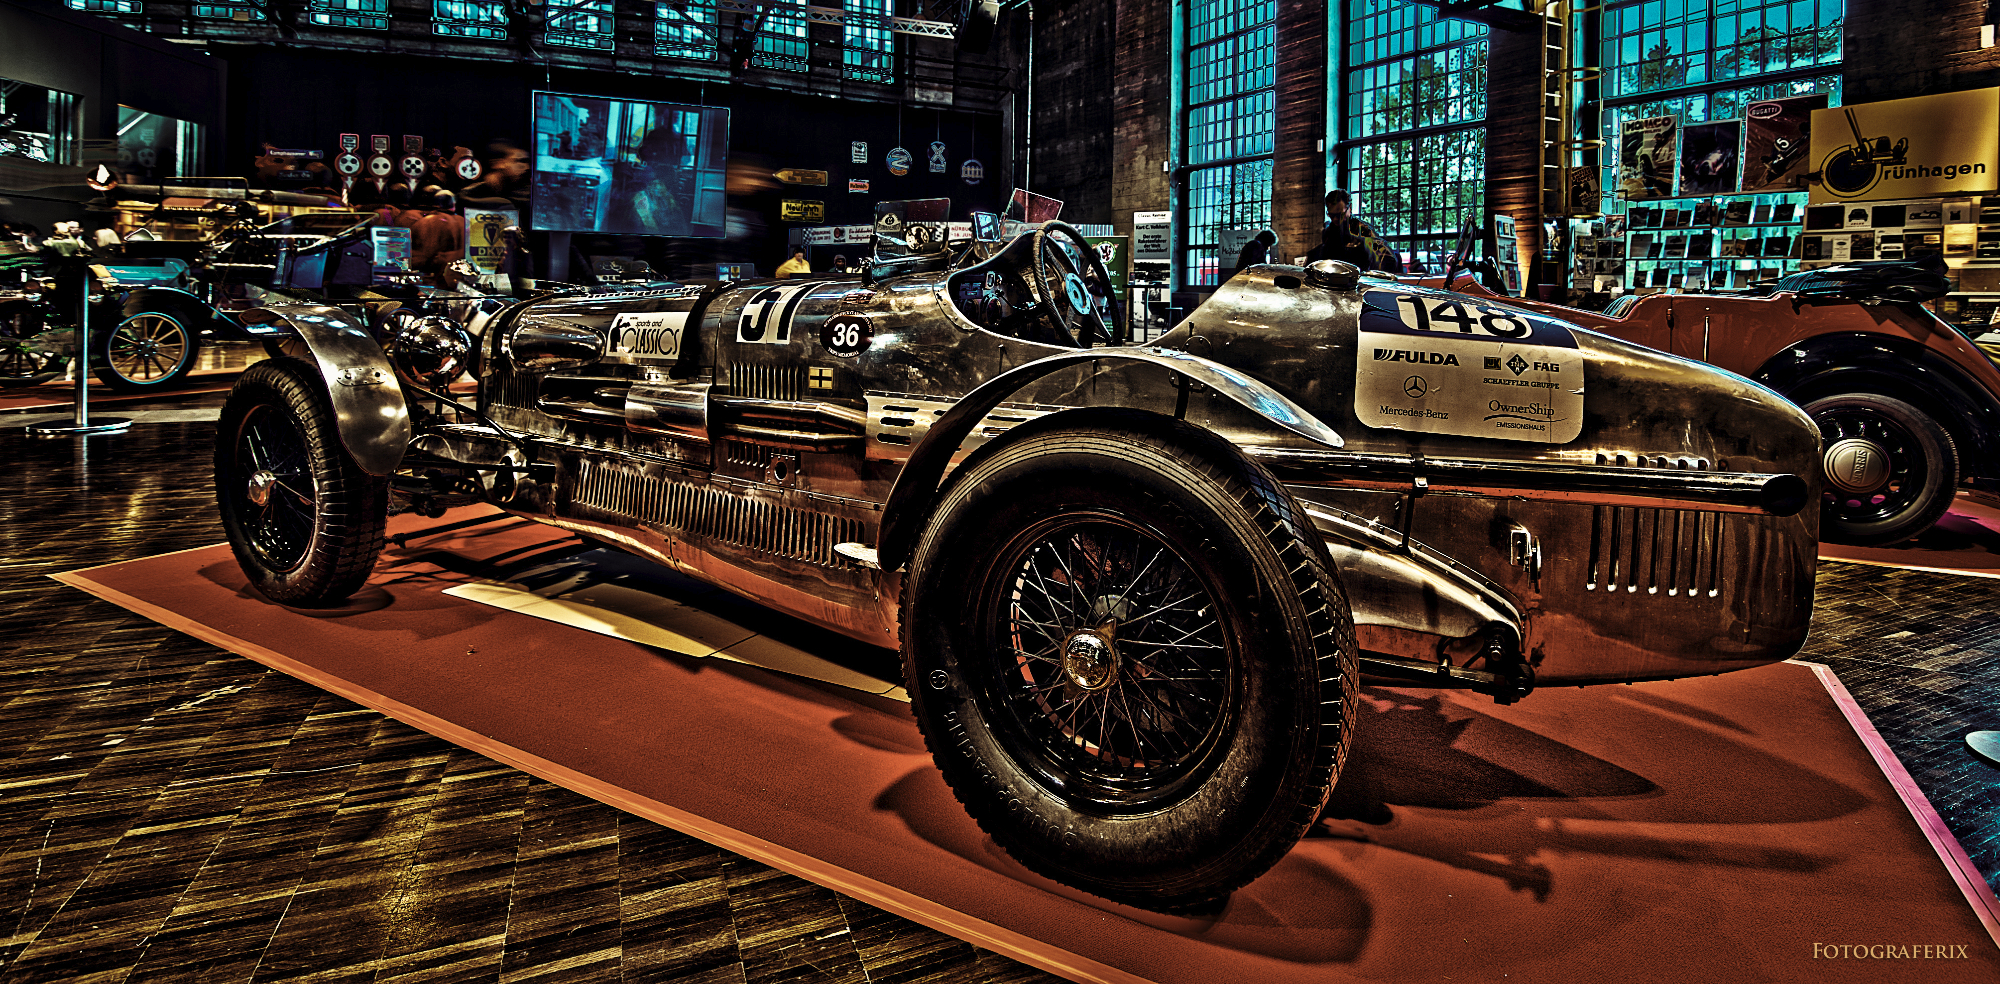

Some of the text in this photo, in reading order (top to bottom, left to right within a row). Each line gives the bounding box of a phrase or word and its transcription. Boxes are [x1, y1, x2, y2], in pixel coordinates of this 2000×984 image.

[1750, 106, 1778, 116] BUGATTI
[1626, 117, 1672, 132] MONACO
[1776, 137, 1790, 148] 5
[635, 318, 664, 329] sports and
[1398, 296, 1527, 338] 148
[621, 328, 679, 355] CLASSICS
[832, 323, 860, 347] 36
[1397, 350, 1460, 367] FULDA
[1533, 361, 1560, 373] FAG
[1483, 377, 1560, 390] SCHAEFFLER GRUPPE
[1379, 405, 1449, 420] Mercedes-Benz
[1488, 399, 1555, 418] OwnerShip
[1496, 421, 1546, 431] EMISSIONSHAUS
[1852, 449, 1867, 484] MORRIS
[996, 790, 1077, 847] DUNLOP
